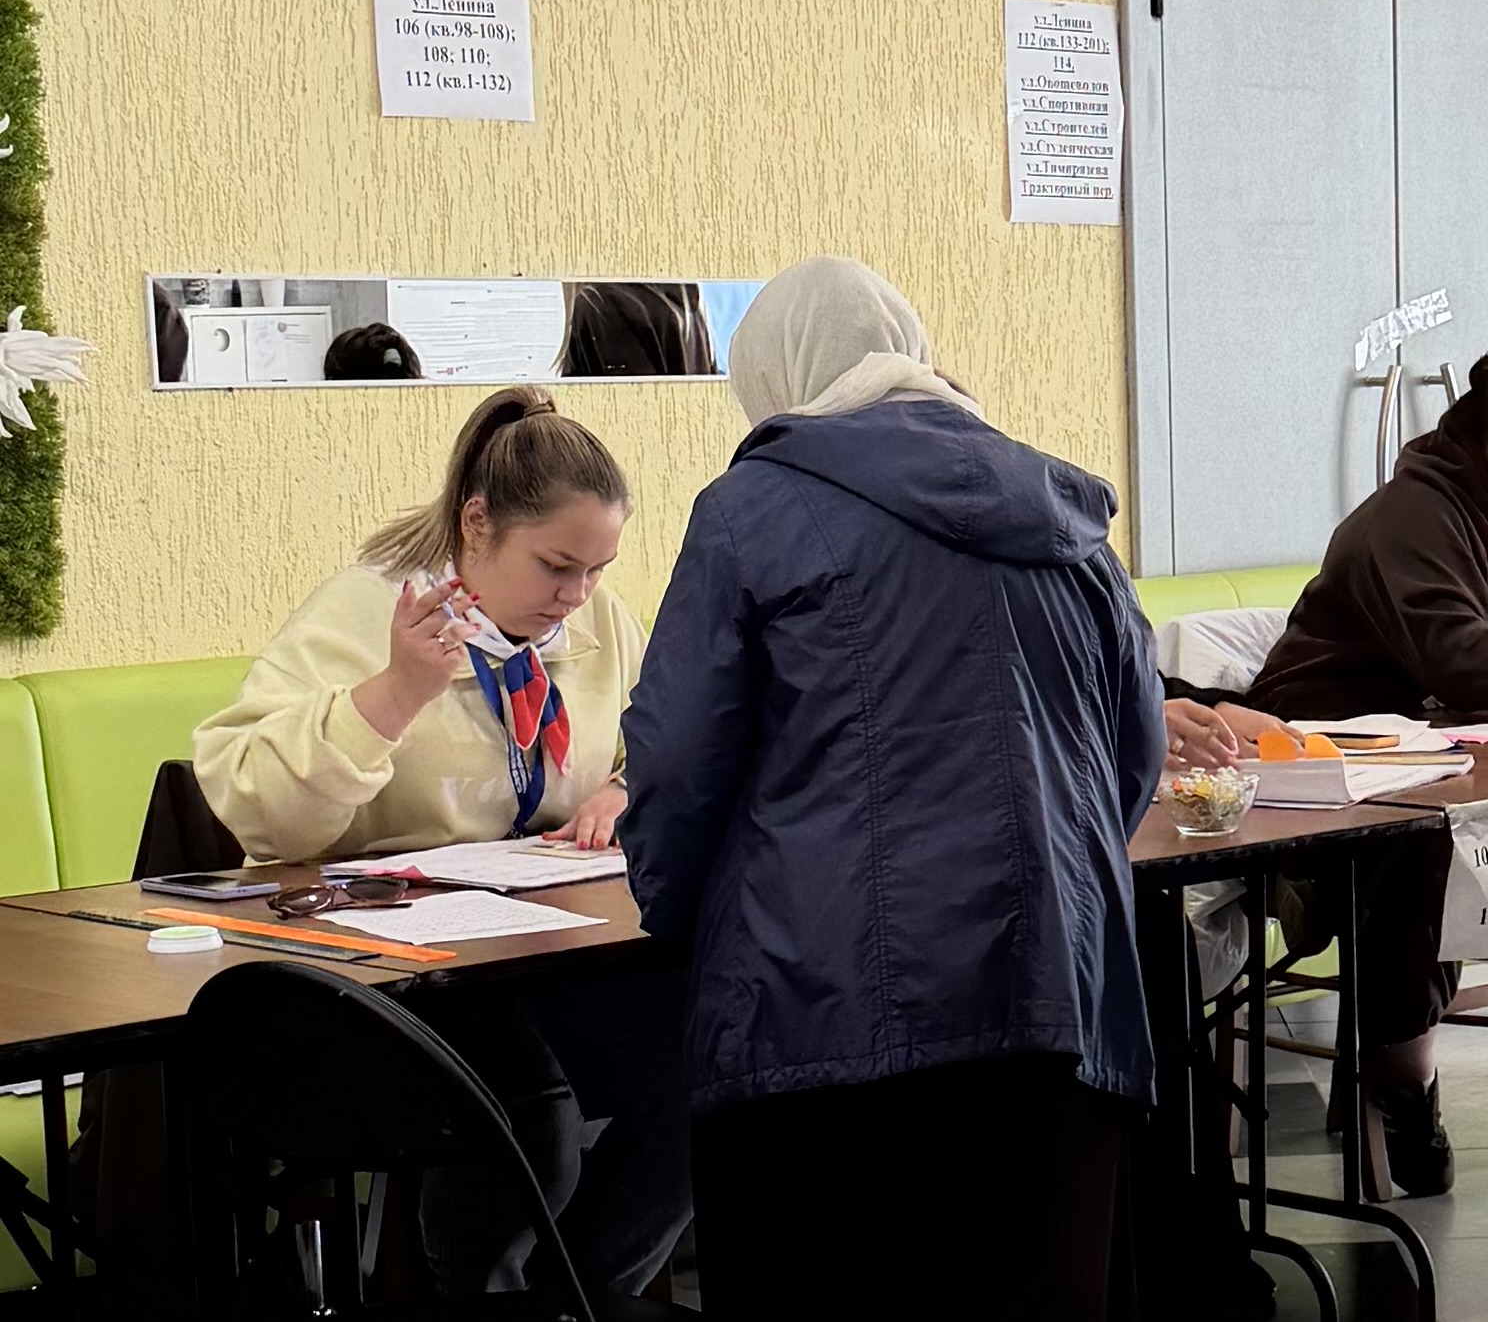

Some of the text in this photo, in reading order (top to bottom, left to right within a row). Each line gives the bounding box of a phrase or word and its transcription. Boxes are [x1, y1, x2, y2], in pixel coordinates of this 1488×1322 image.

[395, 18, 516, 43] 106 (кв.98-108);
[1018, 32, 1036, 46] 112
[424, 46, 491, 68] 108; 110;
[406, 71, 512, 94] 112 (кв.1-132)
